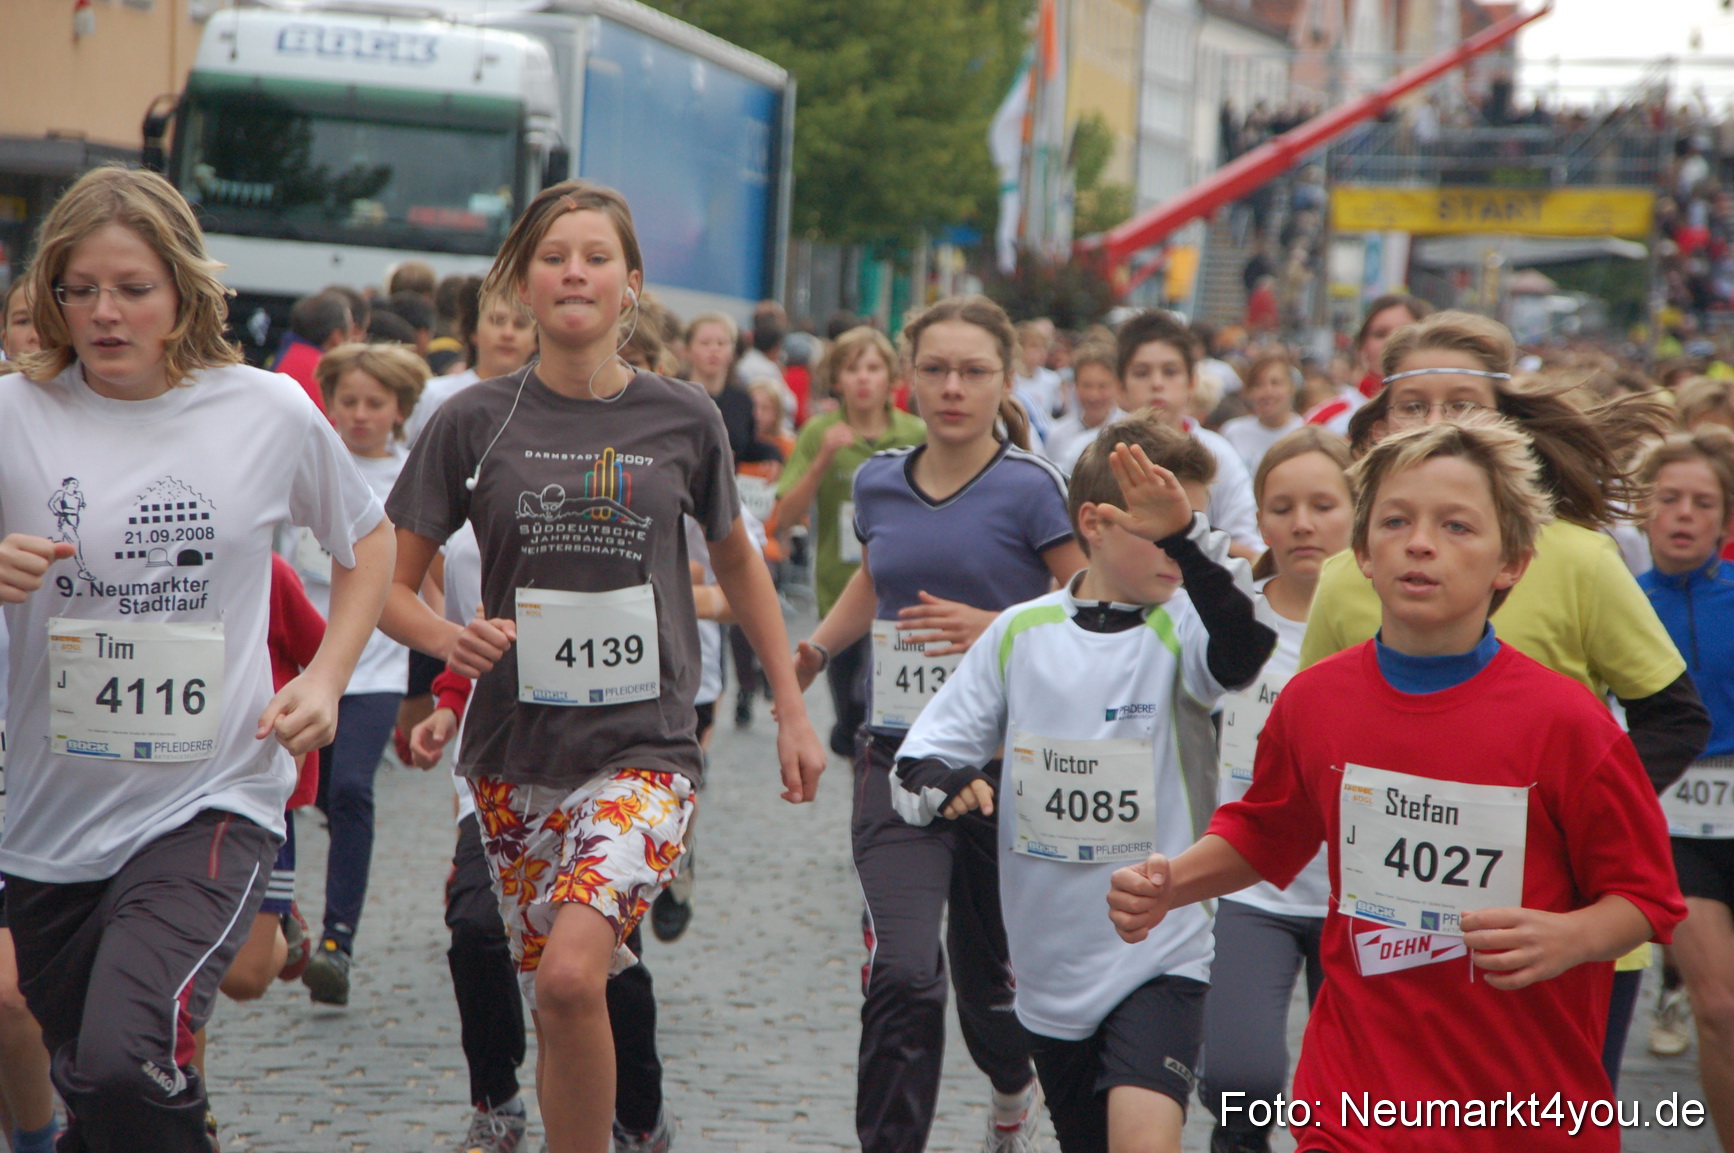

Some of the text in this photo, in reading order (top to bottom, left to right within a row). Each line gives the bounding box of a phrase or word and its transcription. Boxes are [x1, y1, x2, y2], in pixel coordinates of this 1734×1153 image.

[1437, 194, 1542, 222] START
[525, 450, 654, 466] DARMSTADT 2007
[125, 527, 215, 544] 21.09.2008
[519, 522, 646, 541] SÜDDEUTSCHE
[521, 544, 642, 561] MEISTERSCHAFTEN
[56, 576, 209, 598] 9. Neumarkter
[119, 593, 208, 615] Stadtlauf
[95, 633, 134, 660] Tim
[555, 634, 644, 668] 4139
[57, 670, 66, 689] J
[605, 682, 656, 697] PFLEIDERER
[896, 665, 957, 693] 413
[95, 677, 206, 715] 4116
[1228, 712, 1235, 726] J
[66, 739, 109, 752] BOCK
[154, 739, 213, 753] PFLEIDERER
[1043, 748, 1099, 775] Victor
[1017, 780, 1023, 796] J
[1676, 780, 1734, 805] 407
[1045, 788, 1140, 823] 4085
[1385, 787, 1459, 825] Stefan
[1346, 825, 1355, 844] J
[1096, 842, 1153, 856] PFLEIDERER
[1384, 837, 1504, 888] 4027
[1356, 900, 1395, 918] BOCK
[1380, 935, 1432, 960] DEHN
[142, 1060, 174, 1092] JAKO
